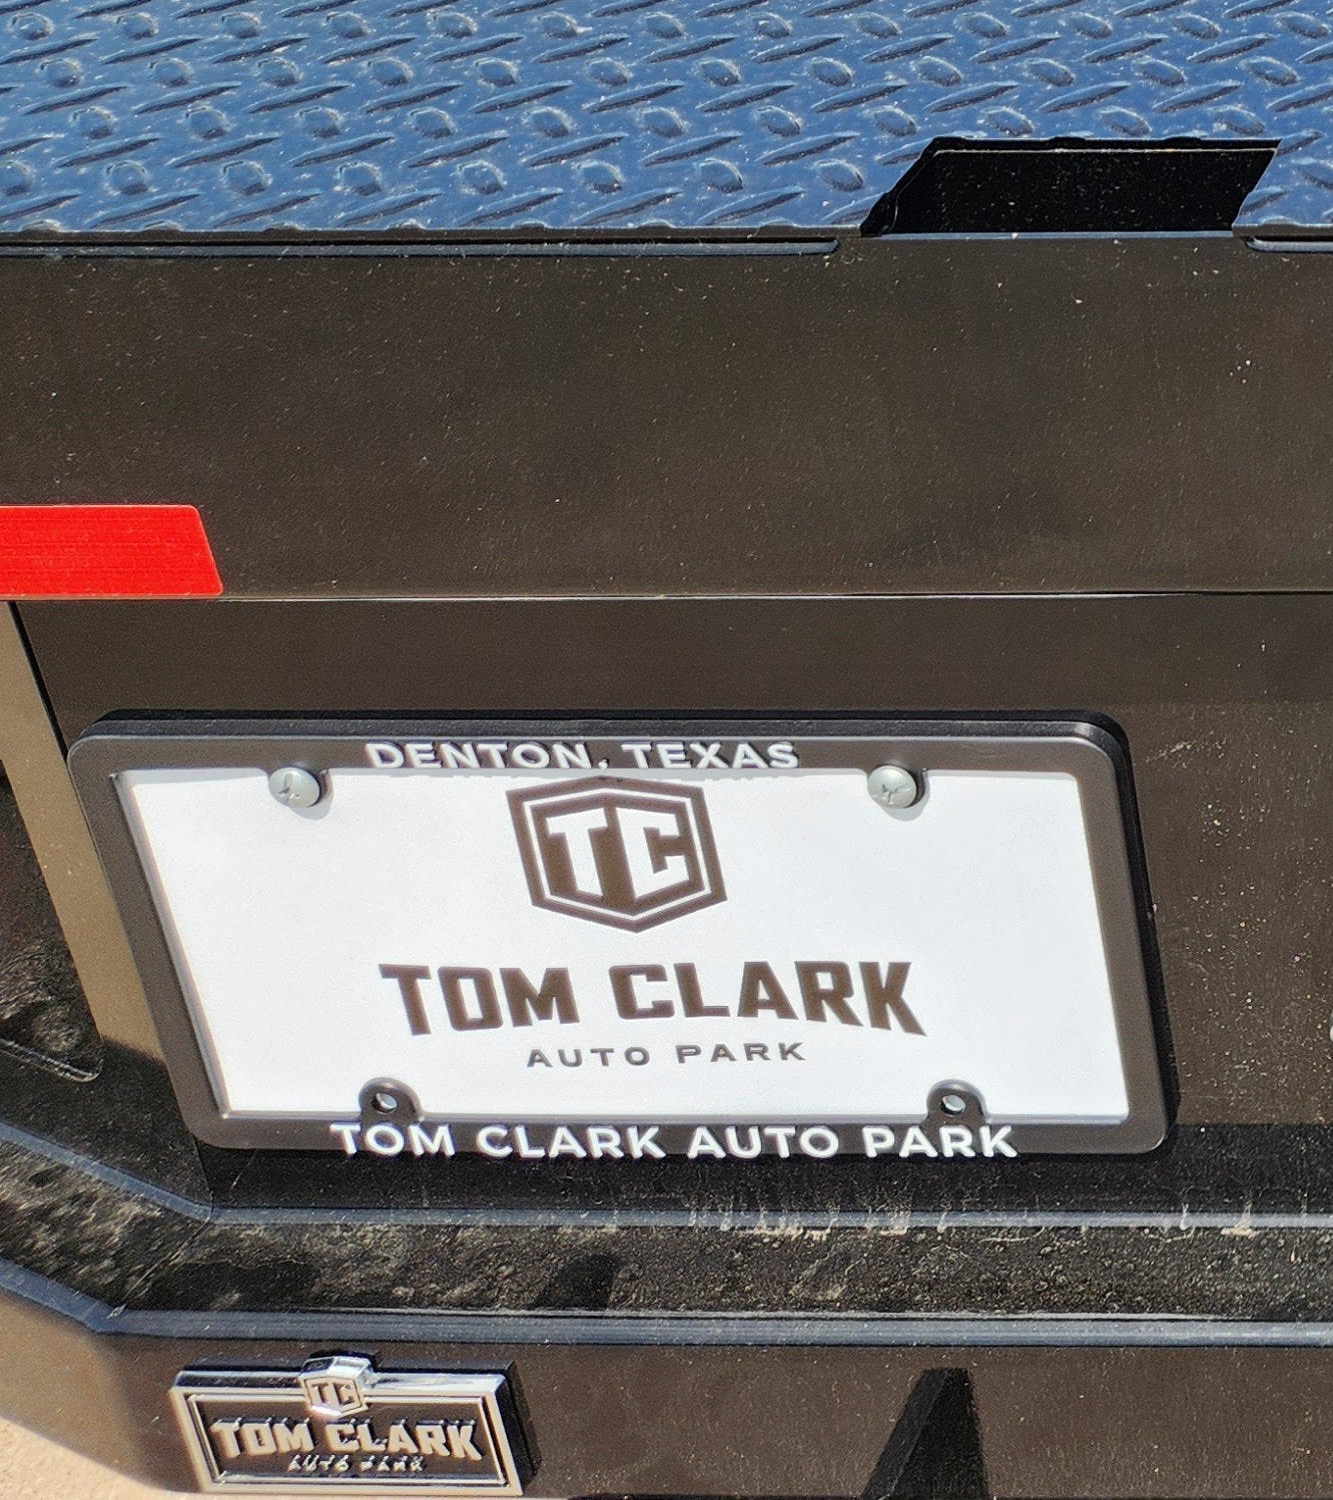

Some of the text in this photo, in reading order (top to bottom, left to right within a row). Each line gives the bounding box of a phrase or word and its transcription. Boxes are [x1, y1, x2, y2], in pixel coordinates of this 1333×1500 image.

[365, 740, 799, 770] DENTON, TEXAS
[545, 807, 690, 900] TC
[378, 961, 927, 1036] TOM CLARK
[526, 1042, 807, 1068] AUTO PARK
[330, 1122, 1018, 1159] TOM CLARK AUTO PARK
[210, 1417, 483, 1461] TOM CLARK
